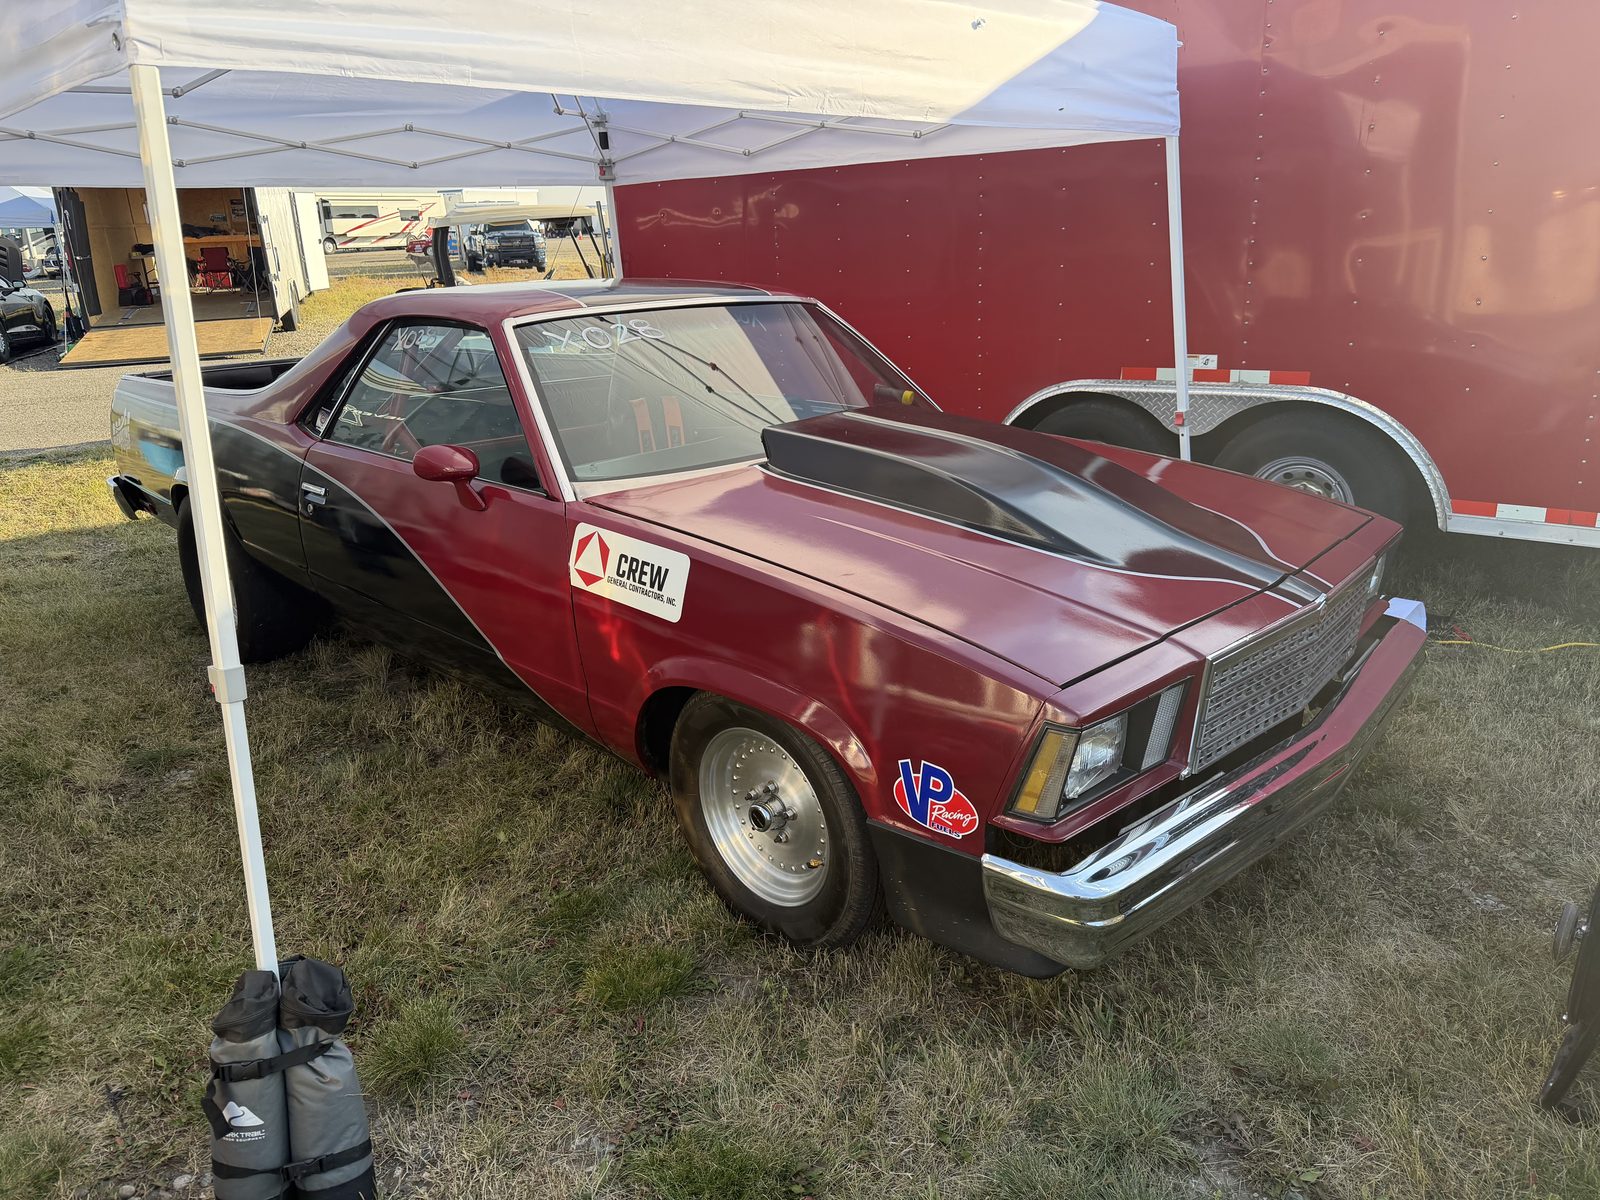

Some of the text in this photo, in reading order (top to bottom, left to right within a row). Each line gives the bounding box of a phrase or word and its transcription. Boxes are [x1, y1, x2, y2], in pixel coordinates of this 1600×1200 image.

[616, 553, 670, 592] CREW
[607, 575, 677, 607] GENERAL CONTRACTORS, INC.
[898, 758, 955, 827] VP
[930, 821, 961, 838] FUELS
[931, 804, 977, 827] Racing
